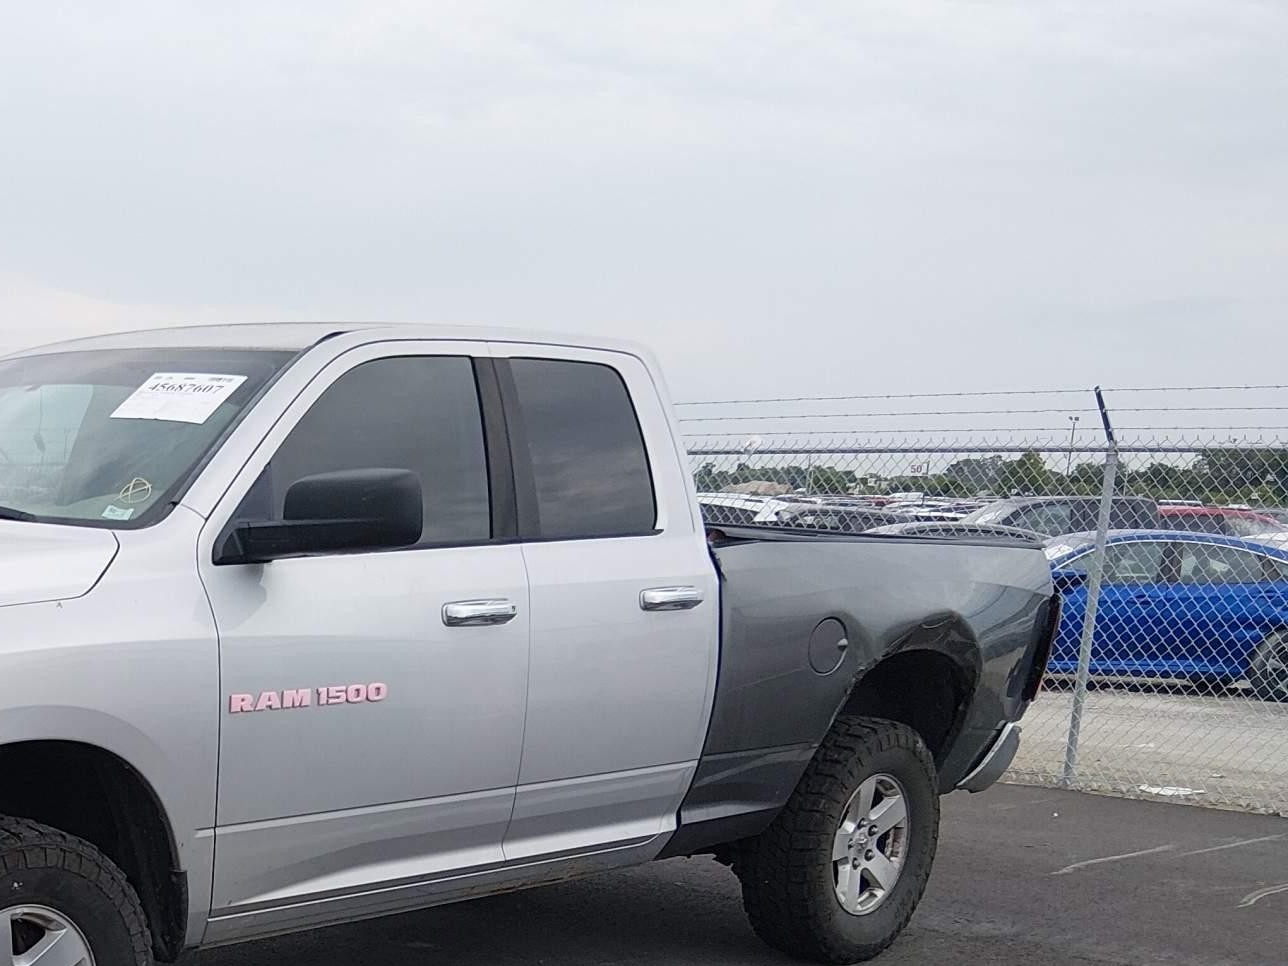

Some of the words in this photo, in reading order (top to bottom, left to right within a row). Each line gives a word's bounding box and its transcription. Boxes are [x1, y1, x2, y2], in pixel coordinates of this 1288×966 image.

[148, 382, 224, 394] 45687607
[910, 464, 923, 474] 50
[229, 688, 312, 714] RAM
[316, 682, 388, 706] 1500
